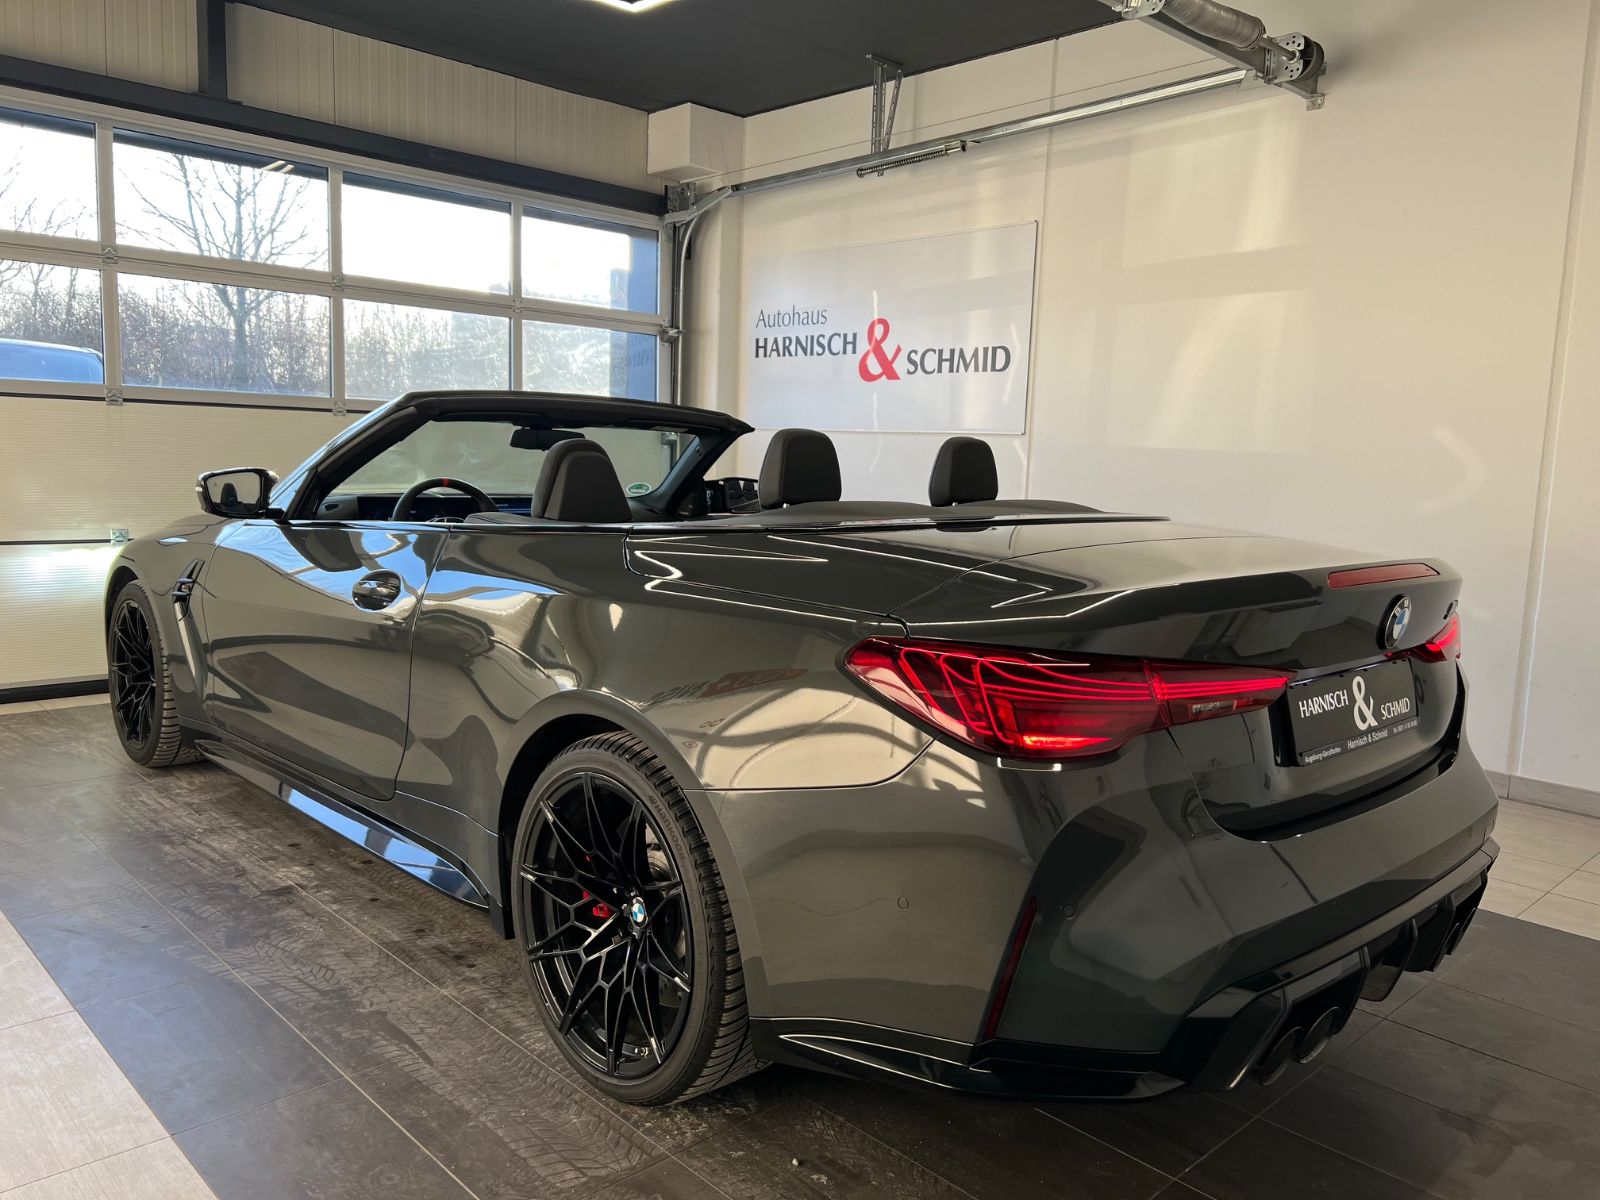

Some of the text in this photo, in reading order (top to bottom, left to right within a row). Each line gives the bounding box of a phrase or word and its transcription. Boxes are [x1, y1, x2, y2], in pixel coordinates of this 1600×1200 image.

[755, 305, 828, 328] Autohaus
[754, 317, 1012, 383] HARNISCH & SCHMID
[1298, 689, 1349, 718] HARNISCH
[1352, 675, 1378, 731] &
[1380, 697, 1410, 720] SCHMID
[1347, 736, 1368, 750] Harnisch
[1372, 728, 1388, 742] Schmid
